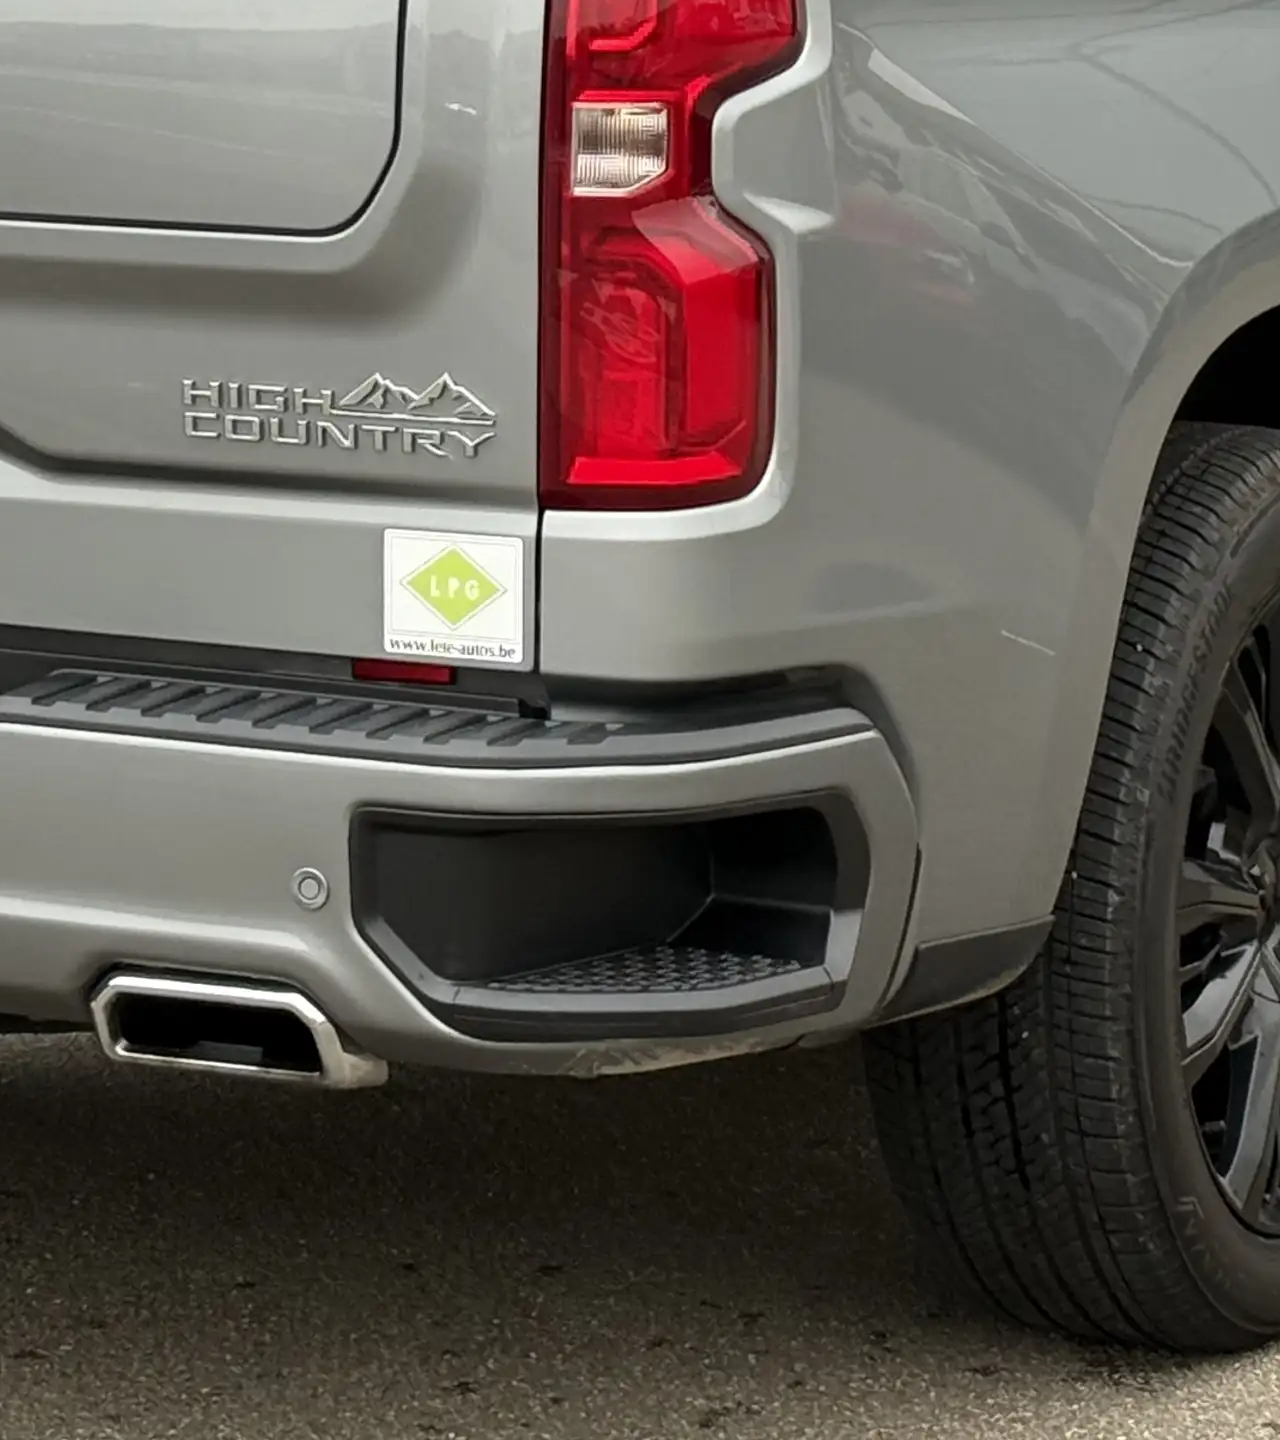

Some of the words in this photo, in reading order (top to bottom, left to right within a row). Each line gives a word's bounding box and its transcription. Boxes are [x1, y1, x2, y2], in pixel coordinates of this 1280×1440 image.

[182, 379, 333, 415] HIGH
[183, 412, 497, 459] COUNTRY
[429, 574, 481, 602] LPG
